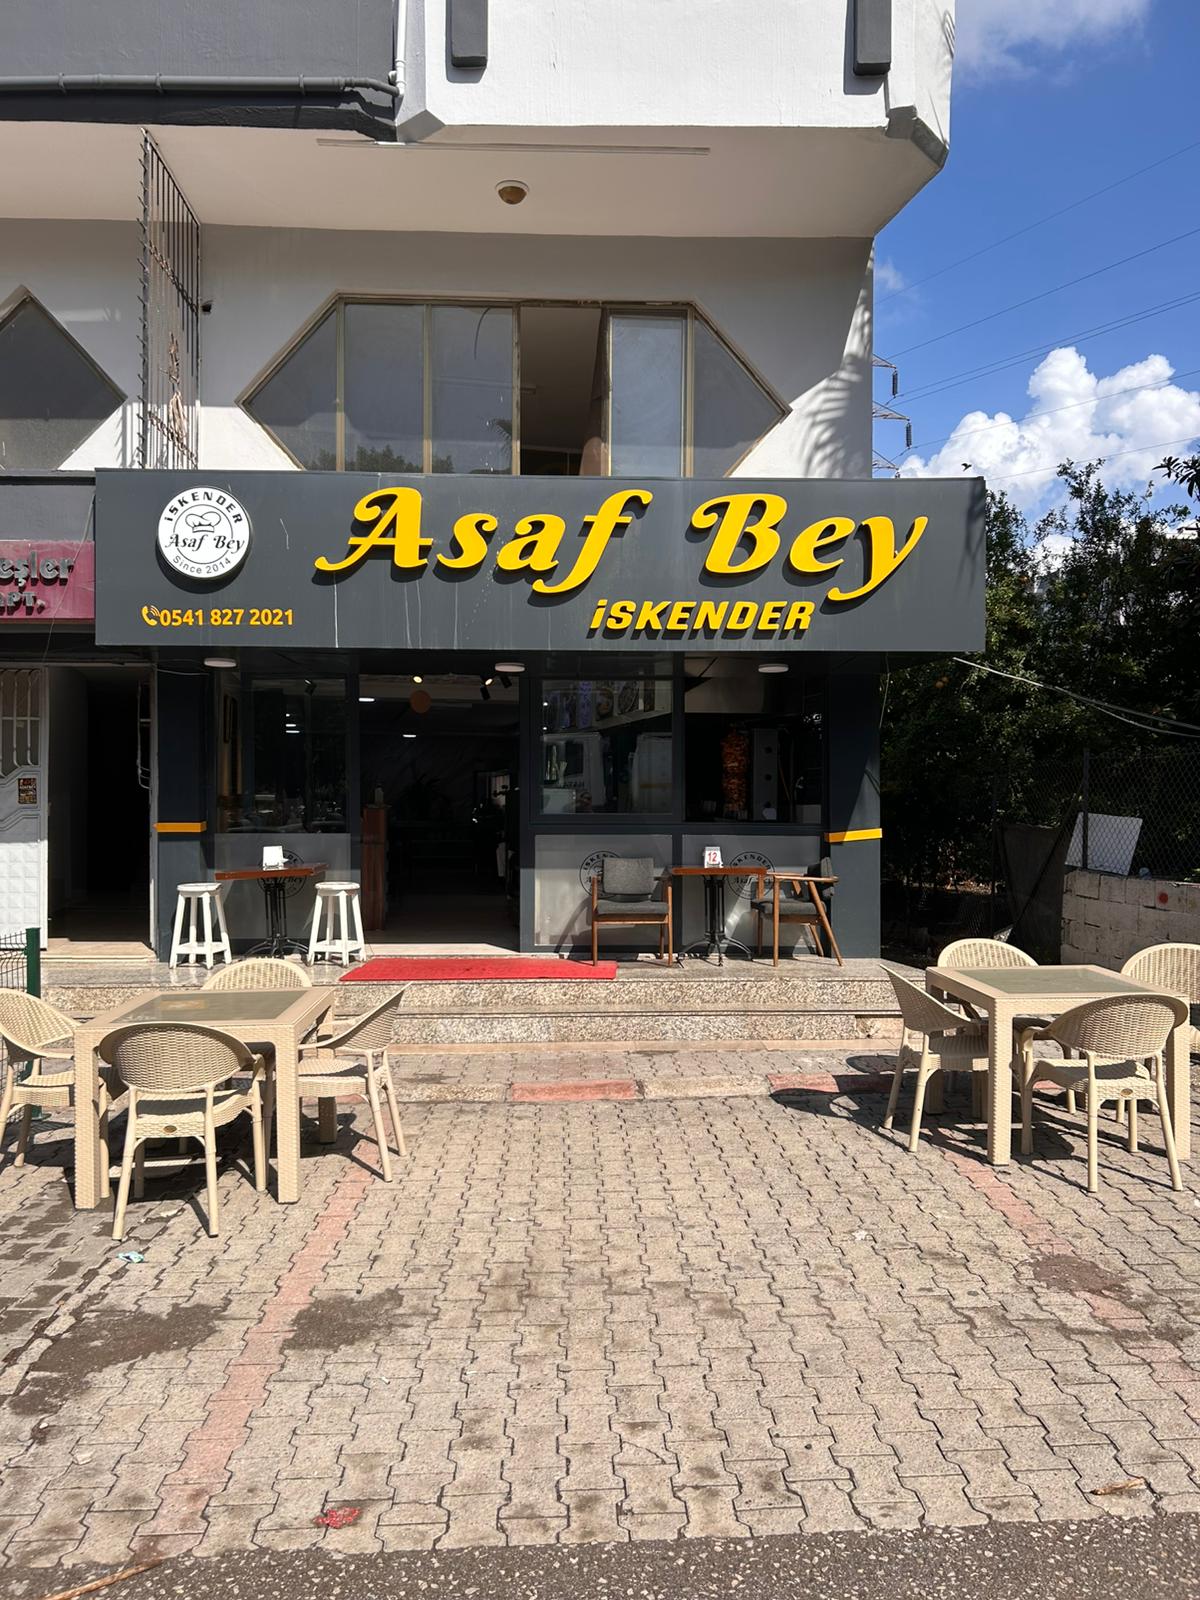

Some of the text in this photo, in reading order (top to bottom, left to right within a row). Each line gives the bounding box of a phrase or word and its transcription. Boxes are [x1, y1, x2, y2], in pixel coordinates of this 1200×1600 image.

[164, 491, 243, 523] iSKENDER
[165, 533, 245, 554] Asaf Bey
[314, 487, 928, 601] Asaf Bey
[173, 555, 231, 574] Since 2014
[159, 609, 293, 626] 0541 827 2021
[590, 599, 815, 630] iSKENDER
[708, 851, 718, 863] 12
